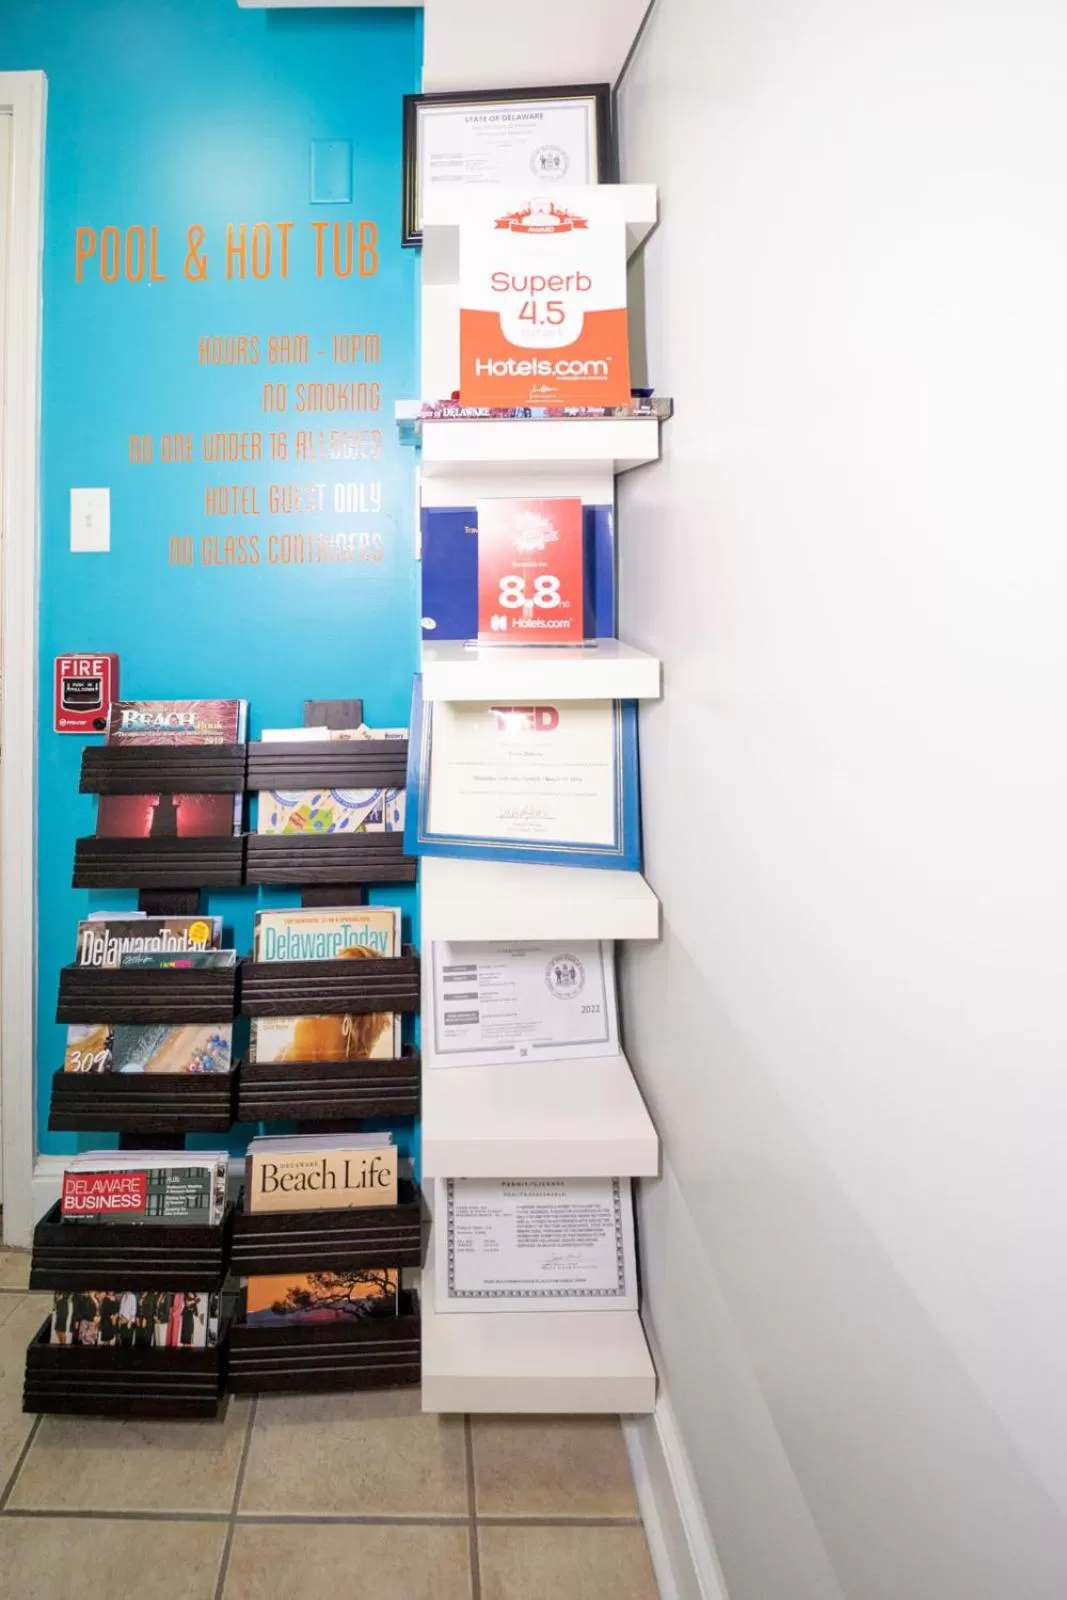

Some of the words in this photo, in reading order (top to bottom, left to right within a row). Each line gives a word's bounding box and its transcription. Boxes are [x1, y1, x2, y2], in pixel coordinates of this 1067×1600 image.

[464, 115, 487, 124] STATE
[489, 114, 499, 122] OF
[502, 112, 544, 121] DELAWARE
[75, 225, 166, 284] POOL
[183, 224, 208, 281] &
[225, 222, 295, 280] HOT
[311, 220, 379, 279] TUB
[490, 271, 592, 297] Superb
[518, 300, 566, 325] 4.5
[198, 335, 260, 367] HOURS
[267, 334, 309, 365] 8AM
[332, 333, 381, 364] 10PM
[475, 357, 609, 376] Hotels.com
[262, 383, 287, 413] NO
[295, 382, 381, 413] SMOKING
[128, 434, 153, 464] NO
[160, 432, 194, 463] ONE
[202, 431, 262, 462] UNDER
[269, 431, 287, 461] 16
[204, 485, 261, 515] HOTEL
[268, 483, 327, 514] GUEST
[334, 482, 382, 513] ONLY
[168, 535, 193, 566] NO
[202, 534, 260, 565] GLASS
[498, 574, 561, 609] 8.8
[512, 617, 571, 629] Hotels.com
[61, 659, 104, 676] FIRE
[121, 709, 197, 732] BEACH
[580, 1004, 600, 1014] 2022
[70, 1048, 108, 1072] 309
[65, 1177, 141, 1194] DELAWARE
[261, 1158, 336, 1193] Beach
[344, 1156, 391, 1189] Life
[64, 1194, 141, 1209] BUSINESS
